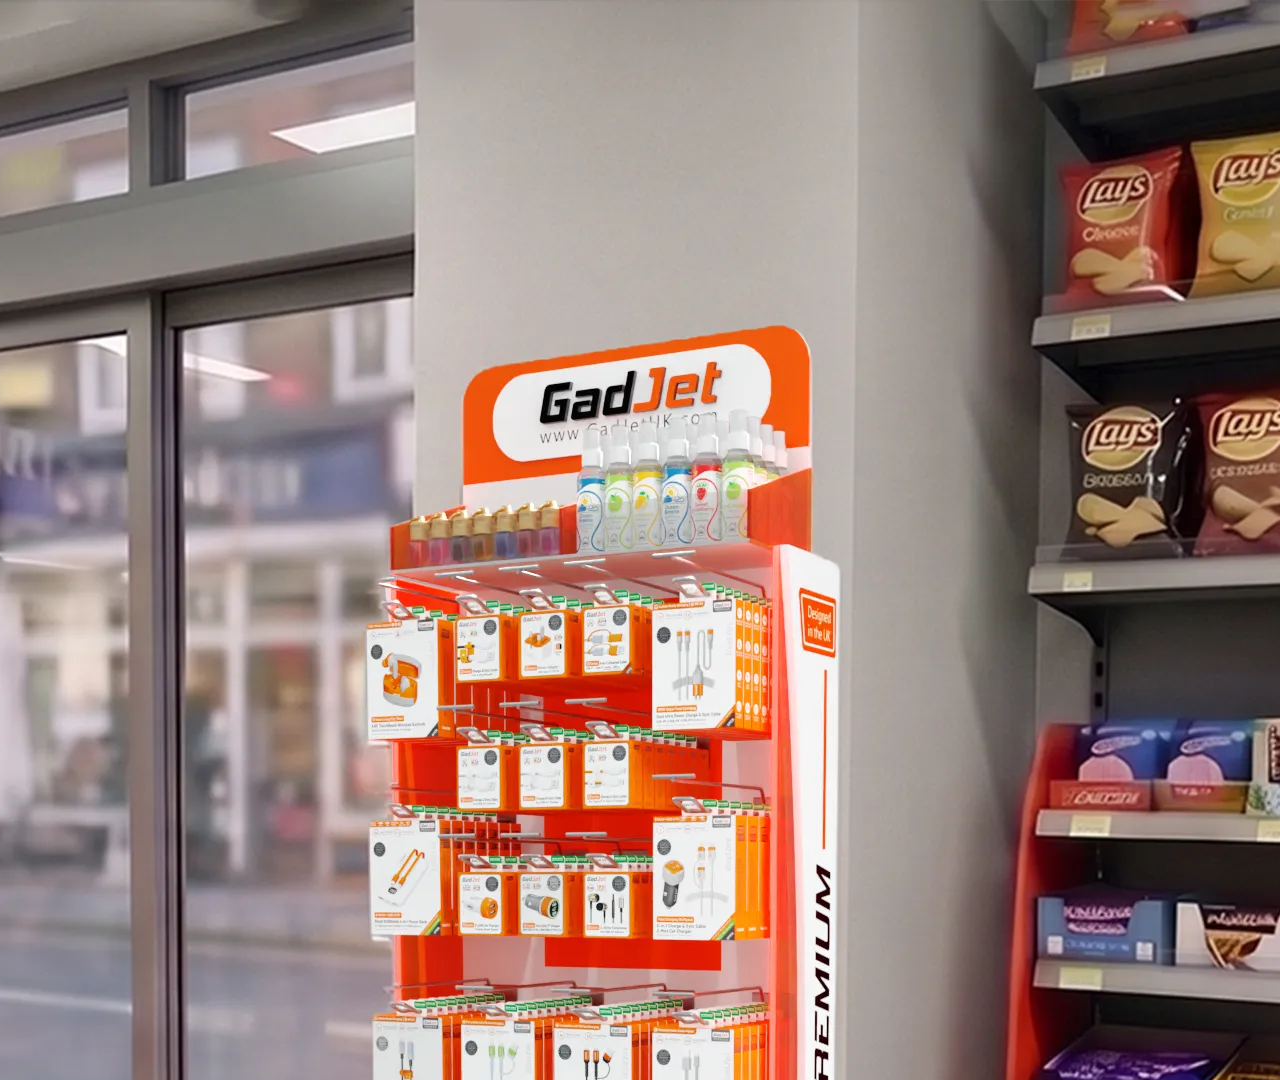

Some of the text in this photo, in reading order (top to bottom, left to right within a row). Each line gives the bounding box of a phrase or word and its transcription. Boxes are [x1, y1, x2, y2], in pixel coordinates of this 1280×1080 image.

[540, 362, 722, 423] GadJet
[807, 605, 832, 625] Designed
[814, 626, 823, 641] the
[823, 628, 832, 643] UK
